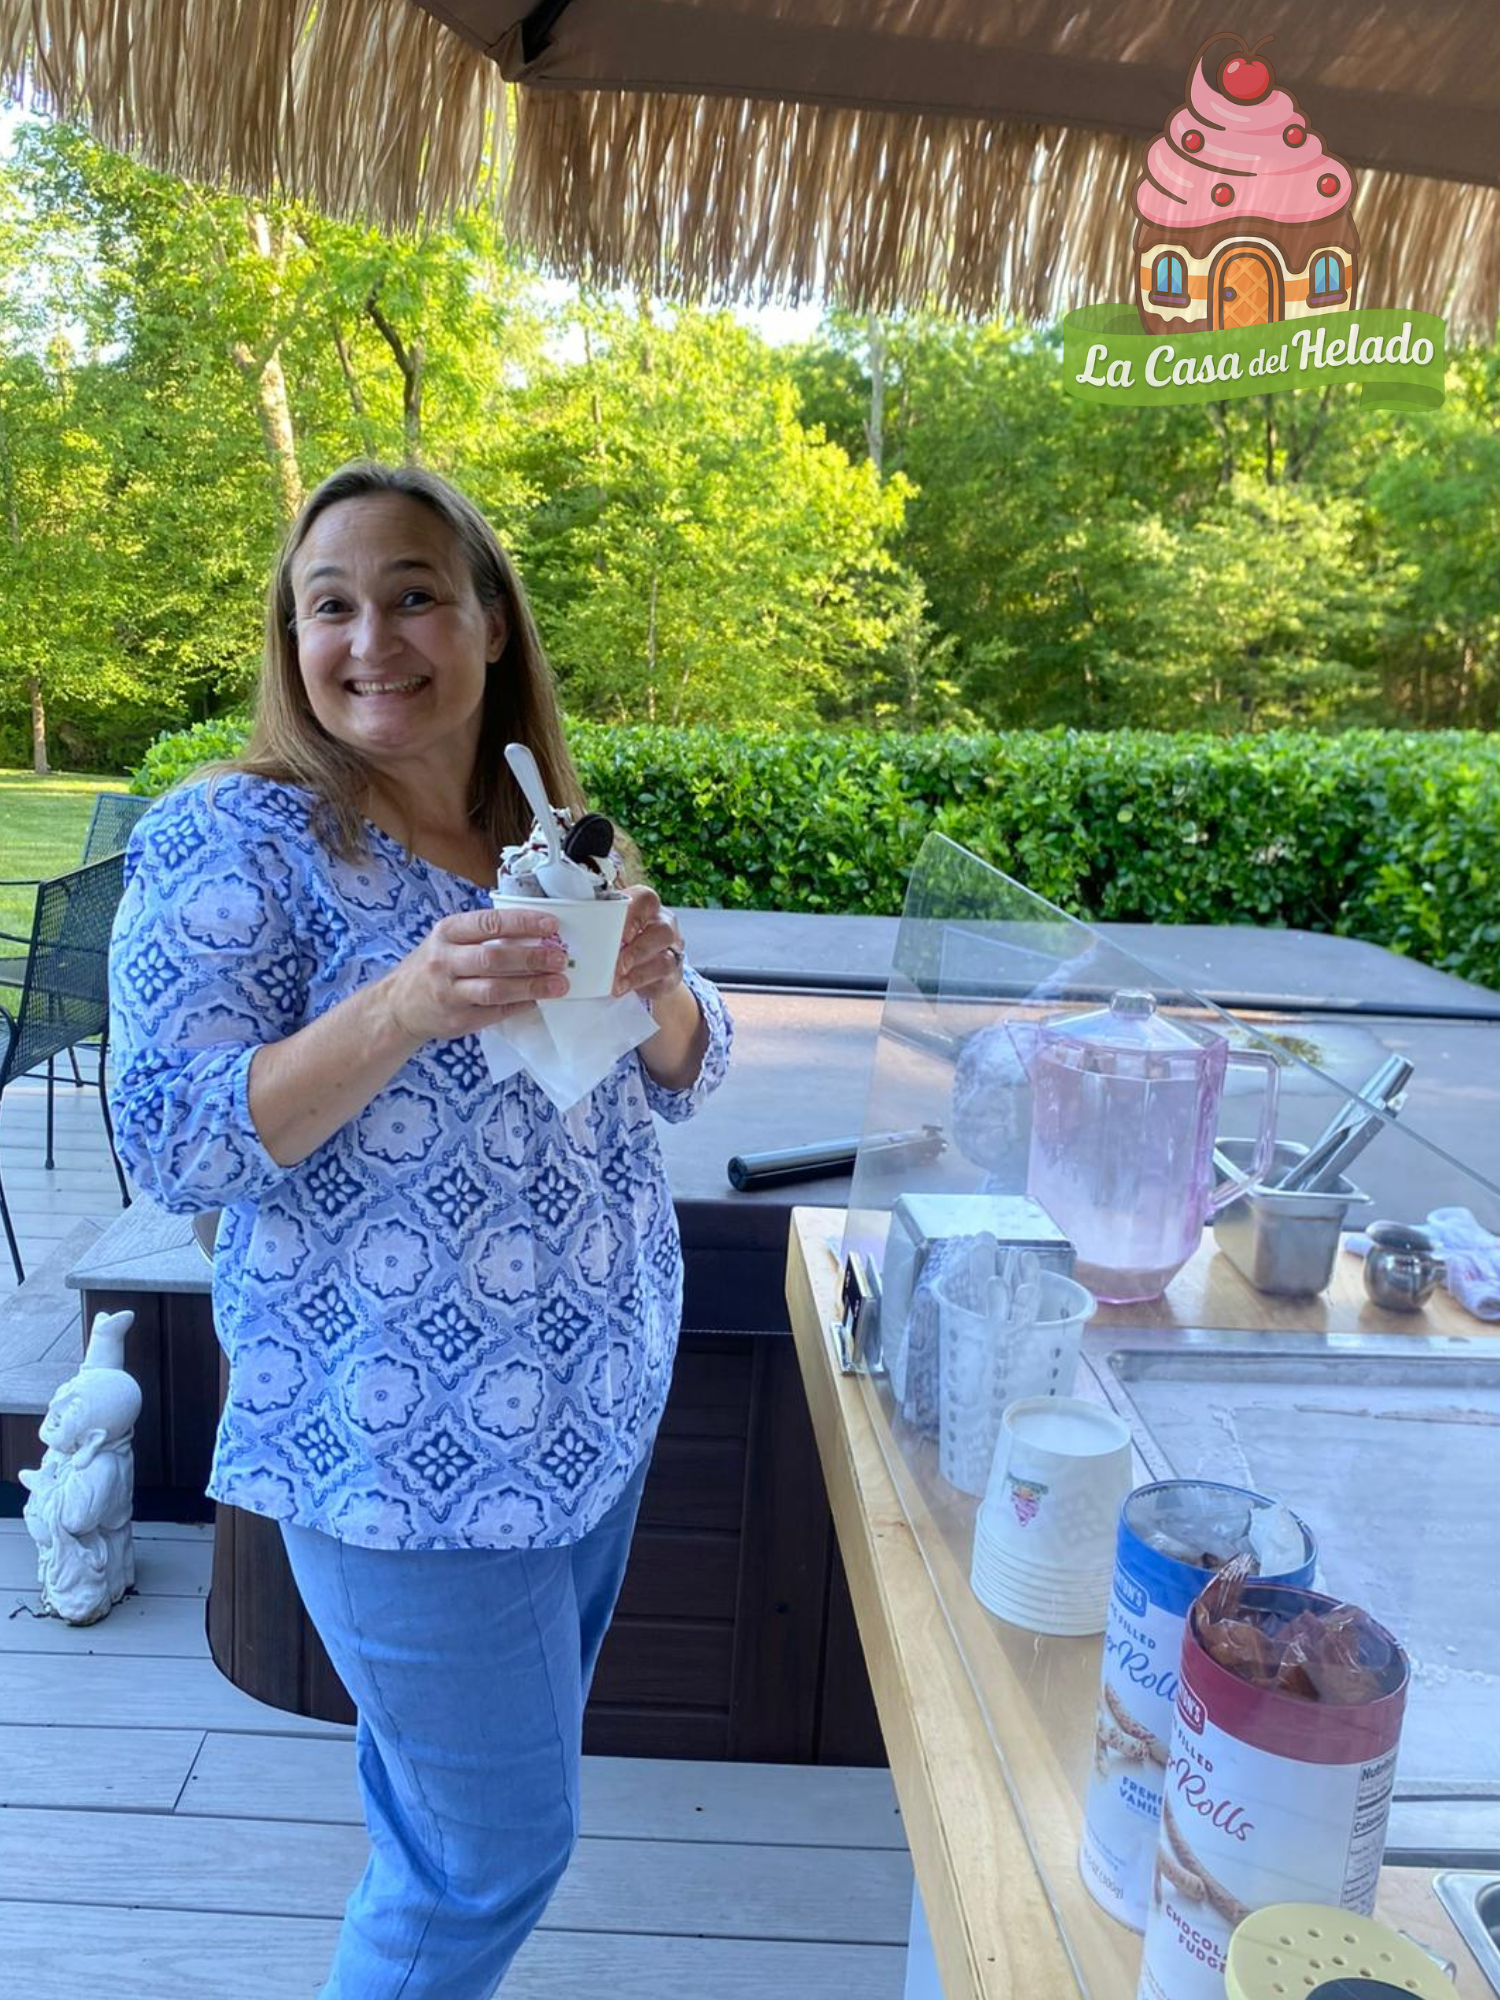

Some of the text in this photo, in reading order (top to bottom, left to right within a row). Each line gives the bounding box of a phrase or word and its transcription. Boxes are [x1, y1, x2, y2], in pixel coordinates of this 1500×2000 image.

[1118, 1615, 1157, 1650] FILLED
[1118, 1640, 1178, 1702] Roll
[1119, 1786, 1162, 1818] VANIL
[1122, 1775, 1163, 1806] FREN
[1176, 1758, 1255, 1841] Rolls
[1166, 1903, 1228, 1960] CHOCOL
